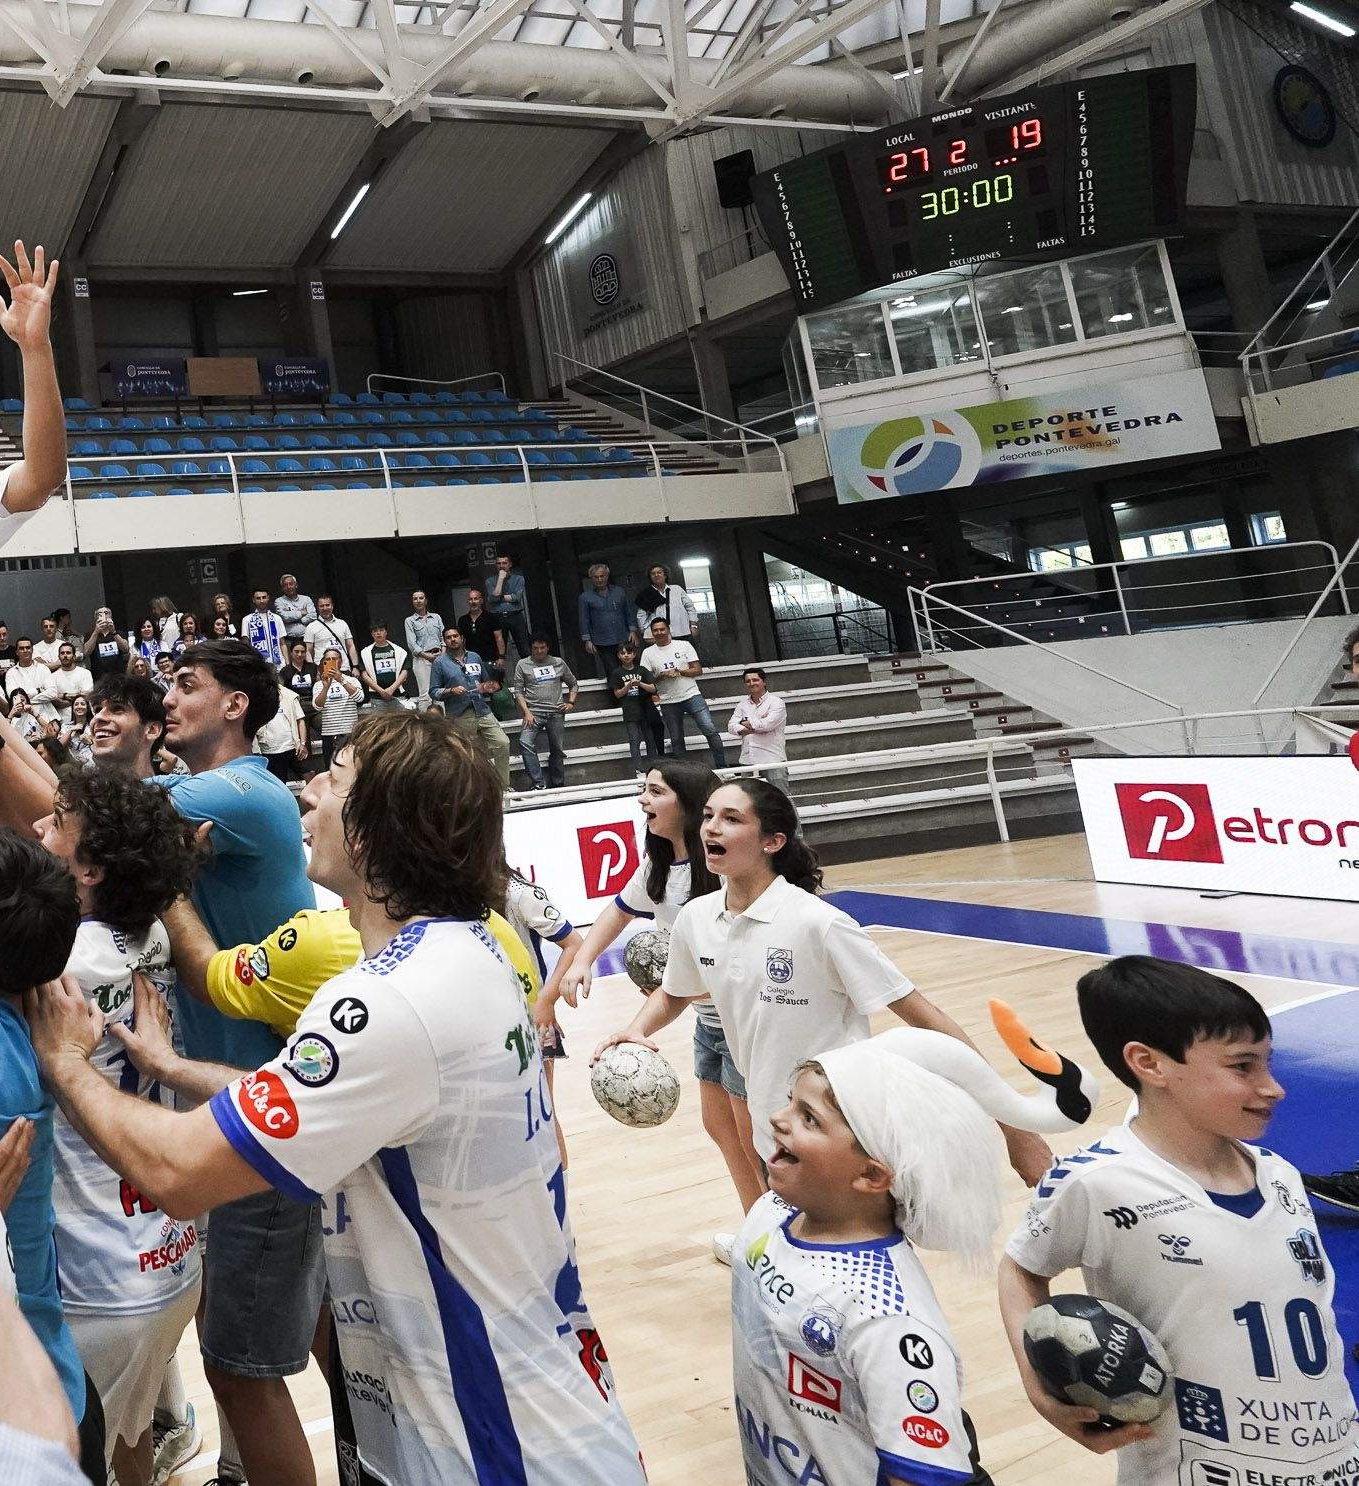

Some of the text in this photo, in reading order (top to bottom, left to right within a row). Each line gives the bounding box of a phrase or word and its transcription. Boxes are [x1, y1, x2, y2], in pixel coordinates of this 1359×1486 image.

[1077, 90, 1086, 101] E
[1078, 102, 1086, 112] 4
[931, 107, 973, 123] MONDO
[1079, 113, 1087, 123] 5
[1079, 124, 1088, 134] 6
[886, 133, 916, 147] LOCAL
[1080, 136, 1088, 146] 7
[890, 119, 1042, 181] 27 2 19
[1080, 147, 1088, 157] 8
[943, 162, 979, 177] PERIODO
[1081, 158, 1089, 168] 9
[920, 174, 1013, 220] 30:00
[1036, 236, 1066, 249] FALTAS
[949, 250, 1001, 268] EXCLUSIONES
[892, 268, 918, 281] FALTAS
[992, 405, 1119, 435] DEPORTE
[995, 412, 1184, 450] PONTEVEDRA
[998, 436, 1122, 463] deportes.pontevedra.gal
[380, 661, 392, 669] 13
[538, 668, 550, 676] 13
[766, 985, 795, 996] Colegio
[138, 1224, 198, 1273] PESCAMAR
[1160, 1252, 1204, 1267] hummel
[1232, 1297, 1333, 1384] 10
[1093, 1322, 1130, 1389] ATORKA
[1236, 1396, 1333, 1422] XUNTA
[905, 1421, 943, 1444] AC&C
[1239, 1422, 1282, 1446] DE
